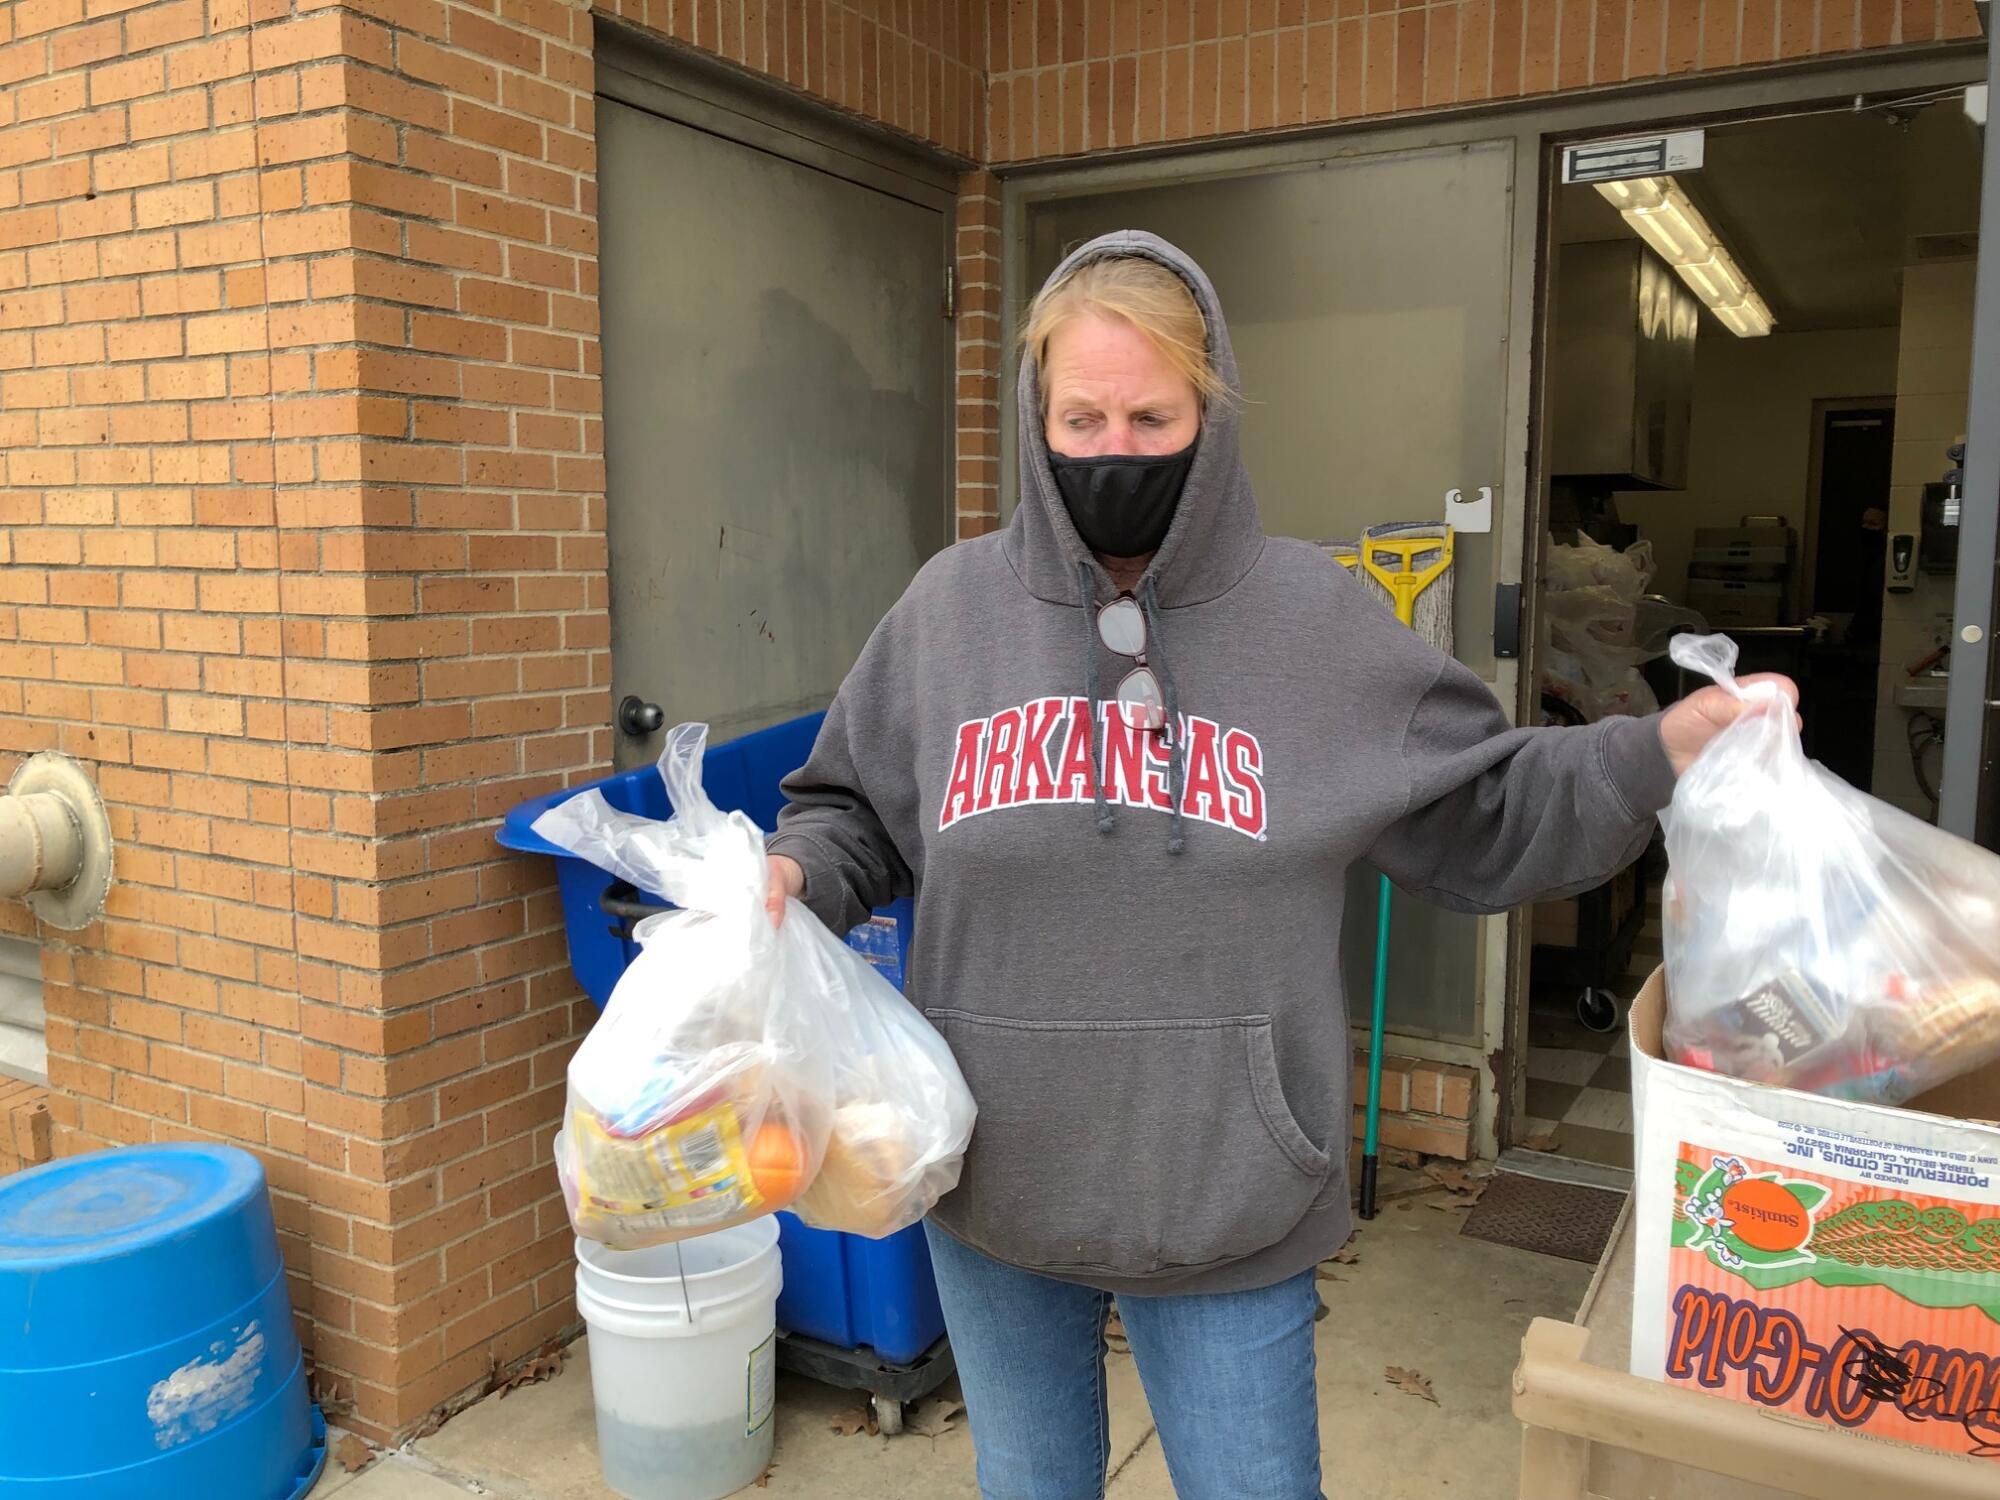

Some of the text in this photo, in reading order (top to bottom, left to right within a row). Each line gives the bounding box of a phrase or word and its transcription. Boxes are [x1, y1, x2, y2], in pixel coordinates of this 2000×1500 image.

[938, 696, 1267, 841] ARKANSAS
[1840, 1133, 1882, 1148] PORTERVILLE
[1796, 1136, 1975, 1175] TERRA BELLA, CALIFORNIA 93270
[1893, 1143, 1933, 1156] TRADEMARK
[1949, 1152, 1967, 1161] GOLD
[1782, 1141, 1990, 1188] PORTERVILLE CITRUS, INC.
[1859, 1171, 1909, 1185] PACKED BY
